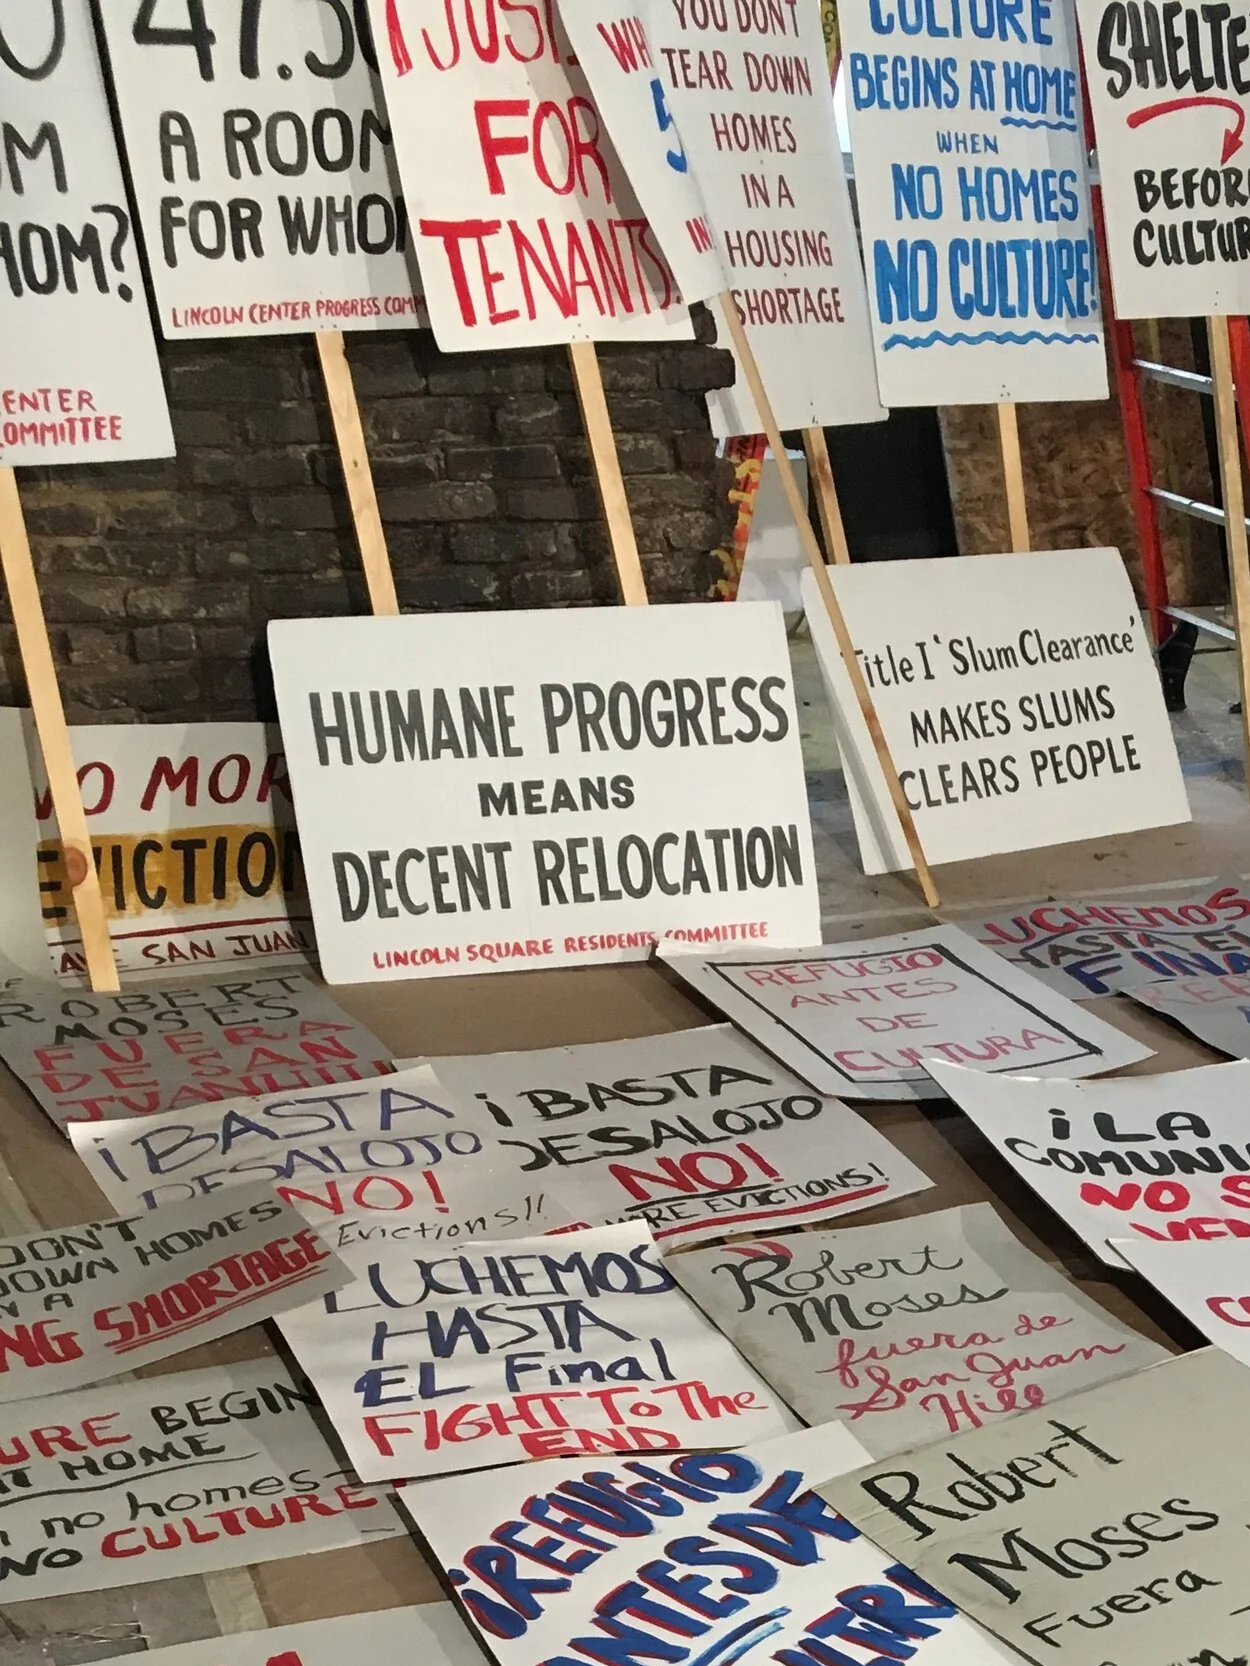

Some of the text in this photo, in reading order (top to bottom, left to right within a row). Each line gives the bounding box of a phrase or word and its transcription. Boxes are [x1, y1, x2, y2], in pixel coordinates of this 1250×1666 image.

[660, 48, 814, 96] TEAR DOWN
[850, 53, 1077, 119] BEGINS AT HOME
[160, 111, 200, 183] A
[473, 97, 610, 203] FOR
[710, 112, 797, 153] HOMES
[935, 130, 999, 155] WHEN
[741, 174, 796, 208] IN A
[891, 163, 1078, 223] NO HOMES
[161, 198, 264, 268] FOR
[724, 230, 833, 268] HOUSING
[873, 239, 938, 325] NO
[171, 298, 381, 328] LINCOLN CENTER PROGRESS
[308, 676, 789, 766] HUMANE PROGRESS
[909, 685, 1116, 748] MAKES SLUMS
[477, 774, 635, 817] MEANS
[899, 734, 1141, 811] CLEARS PEOPLE
[331, 823, 804, 922] DECENT RELOCATION
[141, 931, 309, 966] SAN JUAN
[373, 930, 656, 969] LINCOLN SQUARE RESIDENTS
[745, 950, 944, 989] REFUGIO
[790, 978, 959, 1010] ANTES
[55, 995, 299, 1045] MOSES
[856, 1013, 939, 1033] DE
[33, 1020, 354, 1072] FUERA
[37, 1035, 359, 1094] DE SAN
[608, 1143, 784, 1201] NO!
[1080, 1180, 1191, 1213] NO
[138, 1200, 283, 1267] HOMES
[93, 1228, 331, 1346] SHORTAGE
[372, 1299, 641, 1361] HASTA
[1014, 1313, 1074, 1336] de
[354, 1362, 476, 1407] EL
[967, 1342, 1128, 1390] Juan
[362, 1390, 569, 1457] FIGHT
[920, 1384, 1046, 1433] Hill
[59, 1433, 226, 1481] HOME
[520, 1425, 681, 1458] END
[860, 1418, 1123, 1540] Robert
[41, 1511, 105, 1539] no
[101, 1484, 379, 1559] CULTURE
[948, 1496, 1221, 1605] Moses
